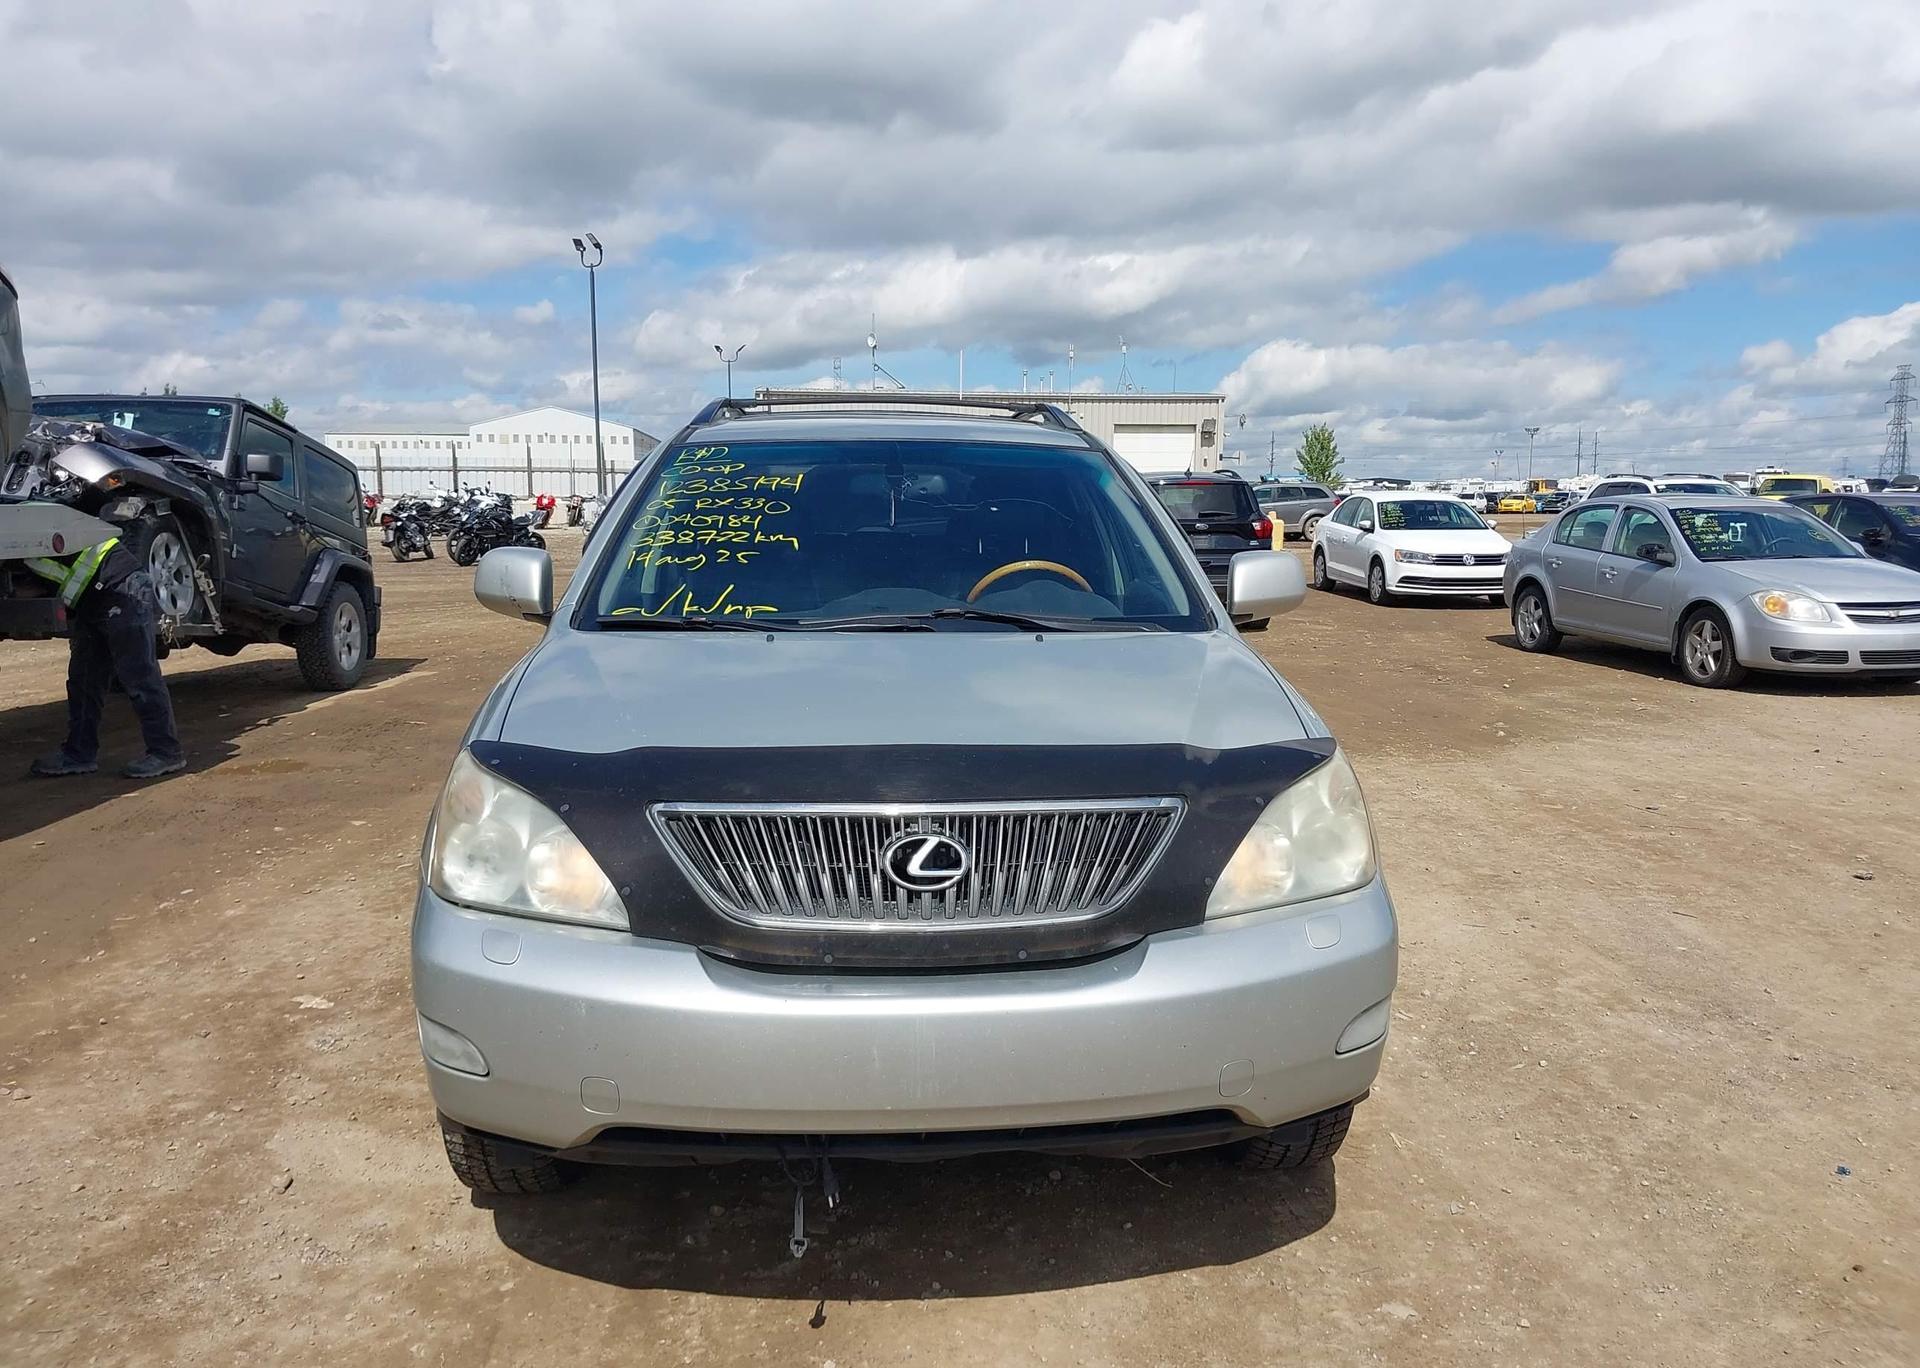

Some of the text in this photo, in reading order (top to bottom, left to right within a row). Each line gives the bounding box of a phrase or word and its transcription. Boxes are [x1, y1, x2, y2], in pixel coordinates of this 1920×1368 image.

[660, 474, 804, 495] 12385194
[695, 498, 735, 510] RX
[734, 498, 791, 514] 330
[716, 550, 760, 564] 25
